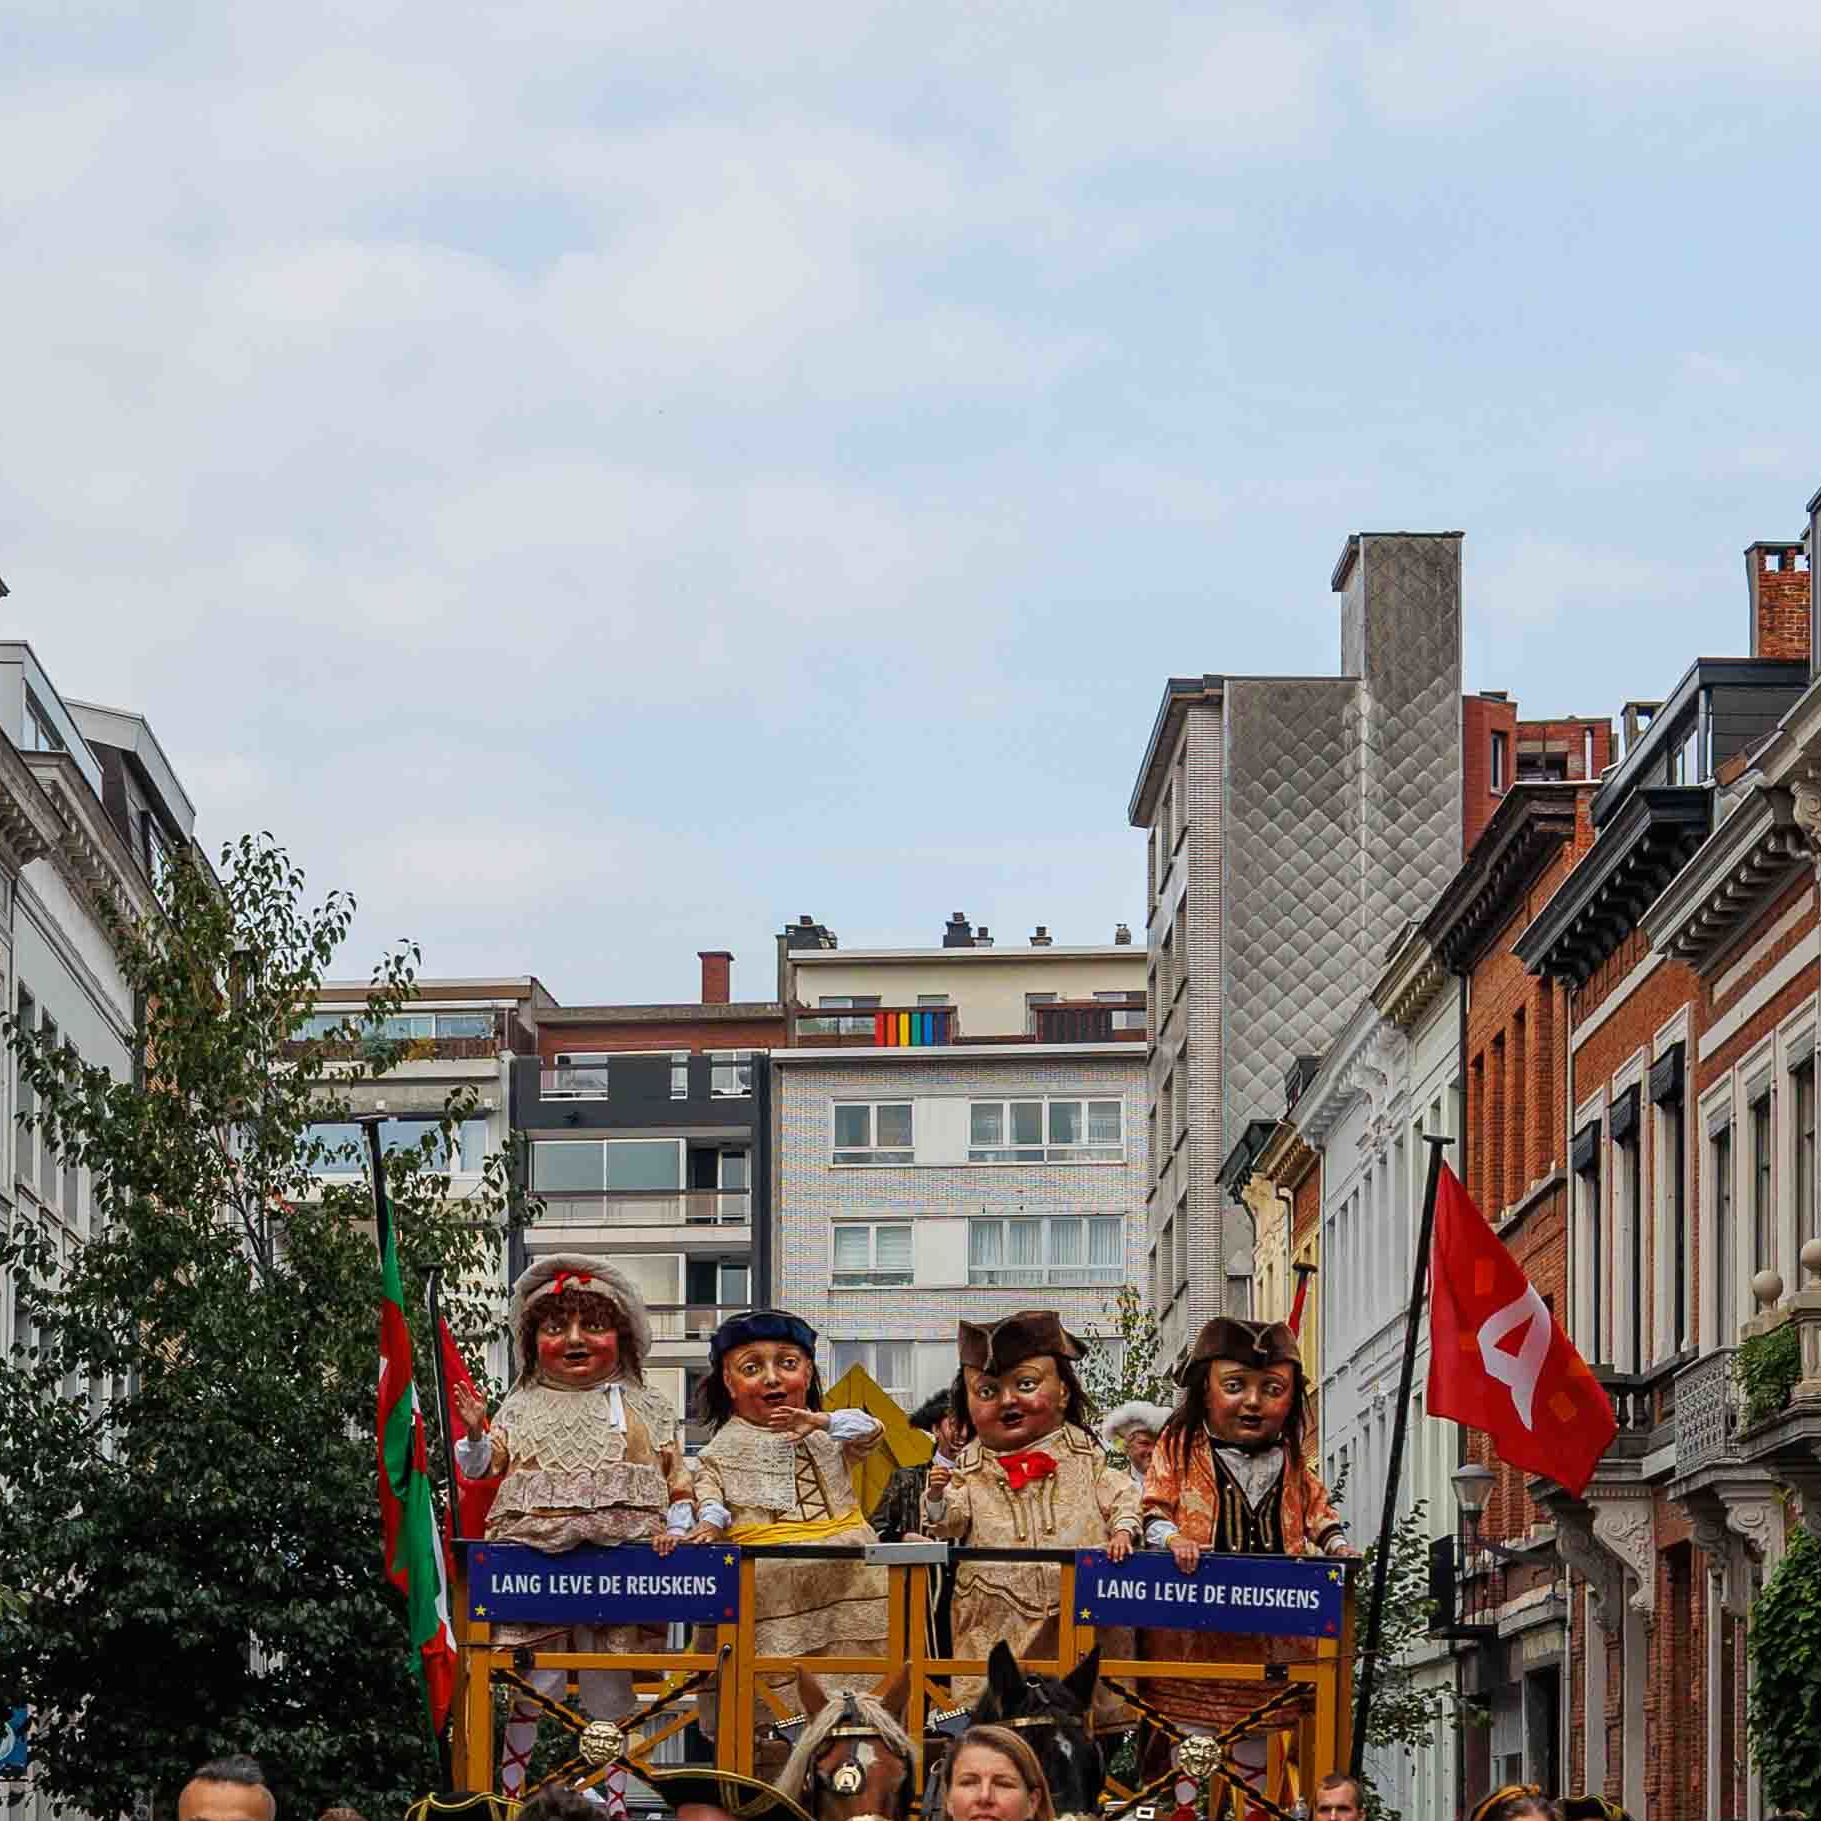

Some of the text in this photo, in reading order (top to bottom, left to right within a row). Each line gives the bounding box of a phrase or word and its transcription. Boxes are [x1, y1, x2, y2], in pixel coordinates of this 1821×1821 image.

[491, 1575, 717, 1595] LANG LEVE DE REUSKENS
[1097, 1579, 1321, 1609] LANG LEVE DE REUSKENS
